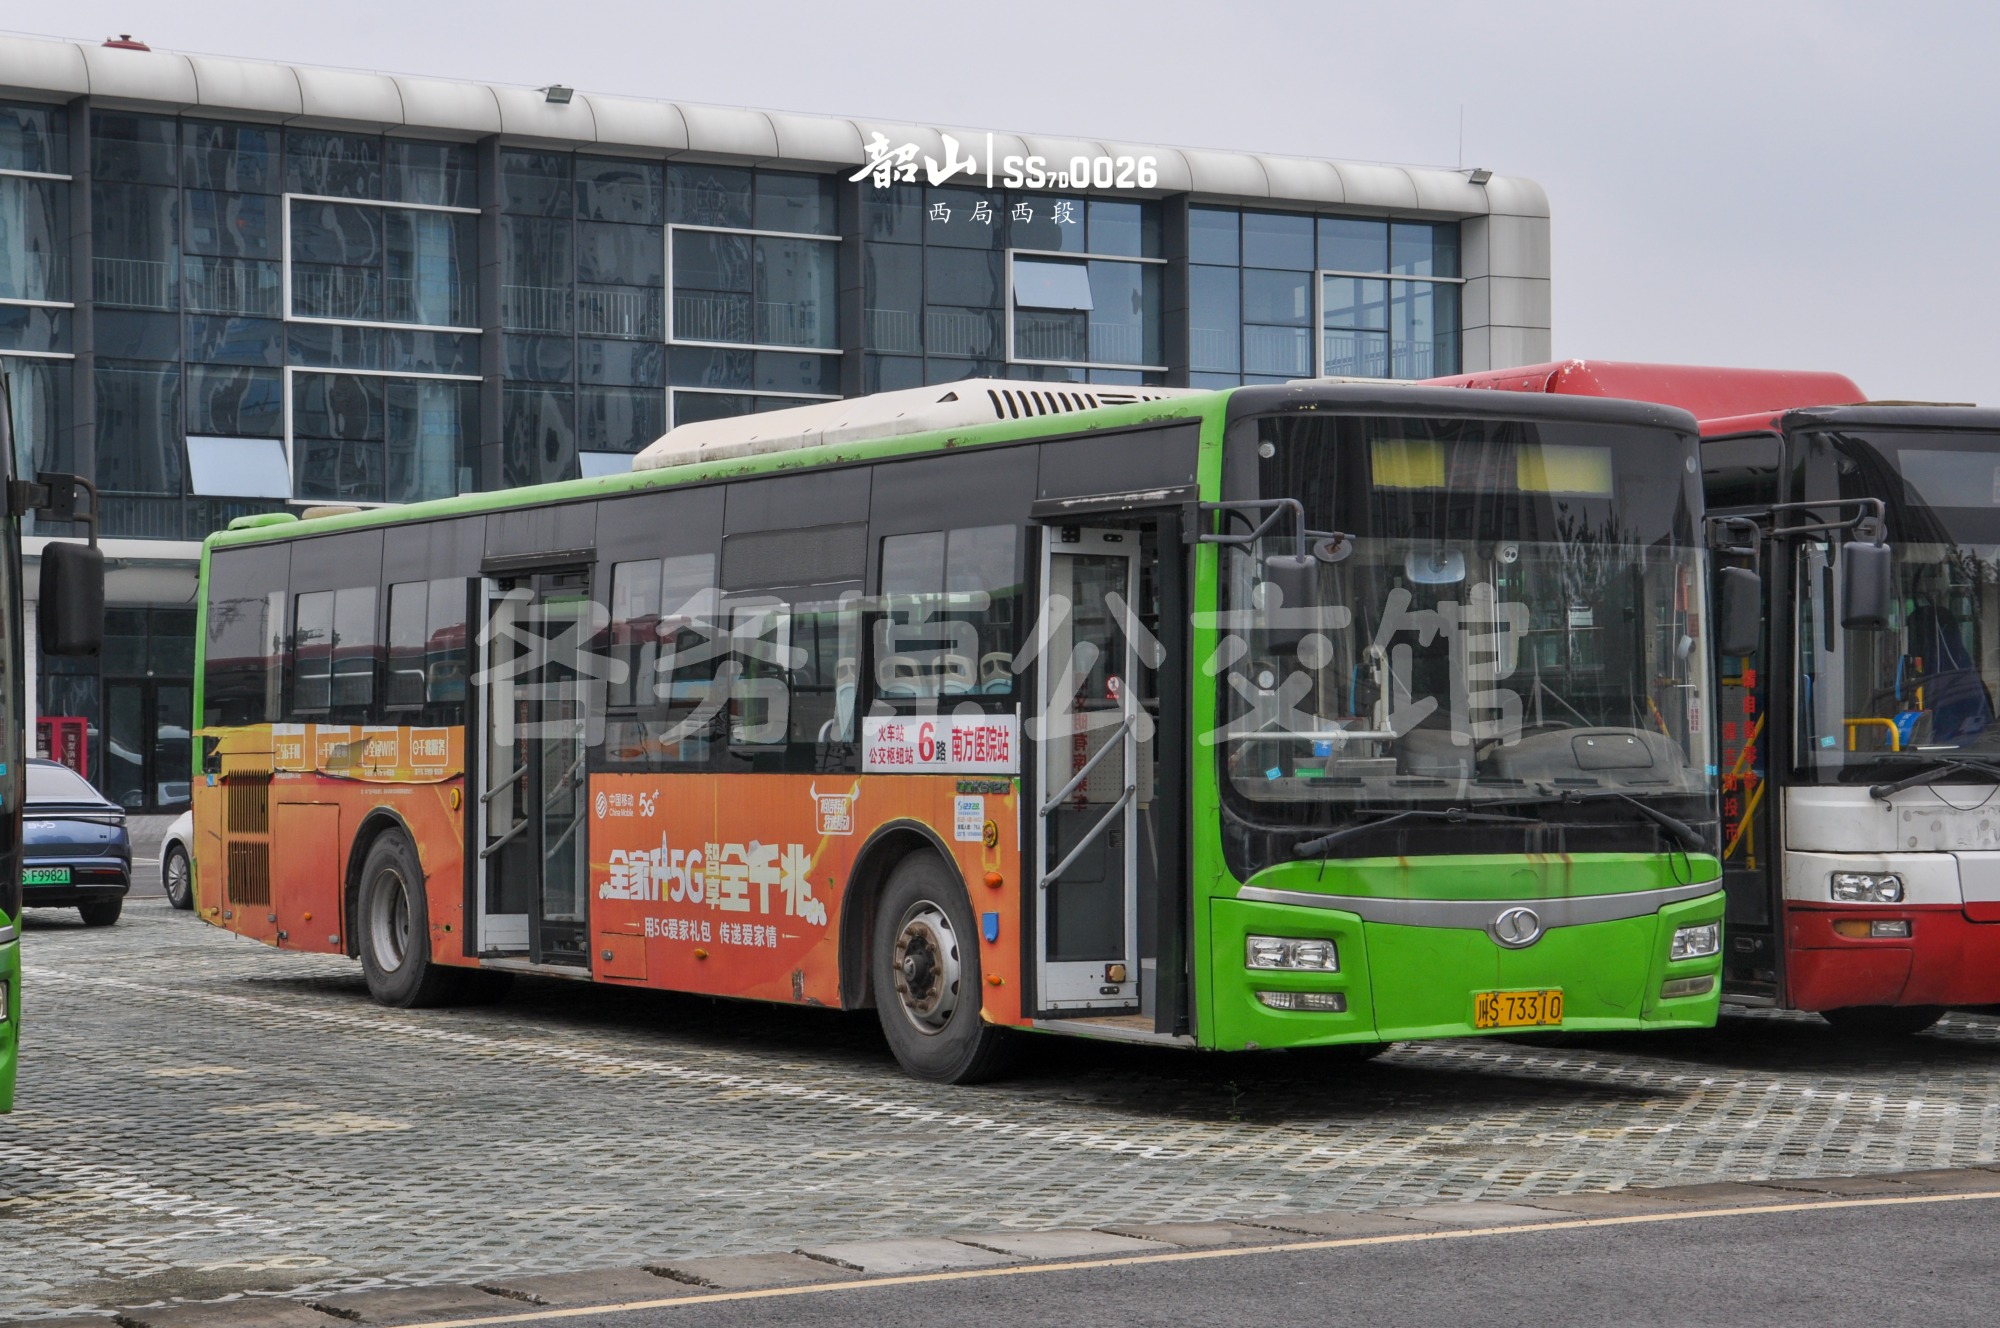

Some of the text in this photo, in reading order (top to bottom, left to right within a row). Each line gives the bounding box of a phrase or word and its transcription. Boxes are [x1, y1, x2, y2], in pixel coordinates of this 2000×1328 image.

[878, 724, 905, 743] 火车站
[67, 734, 76, 771] 微型消防
[951, 725, 1009, 763] 南方医院站
[869, 746, 914, 765] 公交枢纽站
[1723, 722, 1739, 842] 请主动投币
[609, 793, 634, 807] 中国移动
[609, 808, 634, 817] China Mobile
[27, 821, 56, 829] BYD
[644, 917, 777, 948] 用5G爱家礼包 传递爱家情
